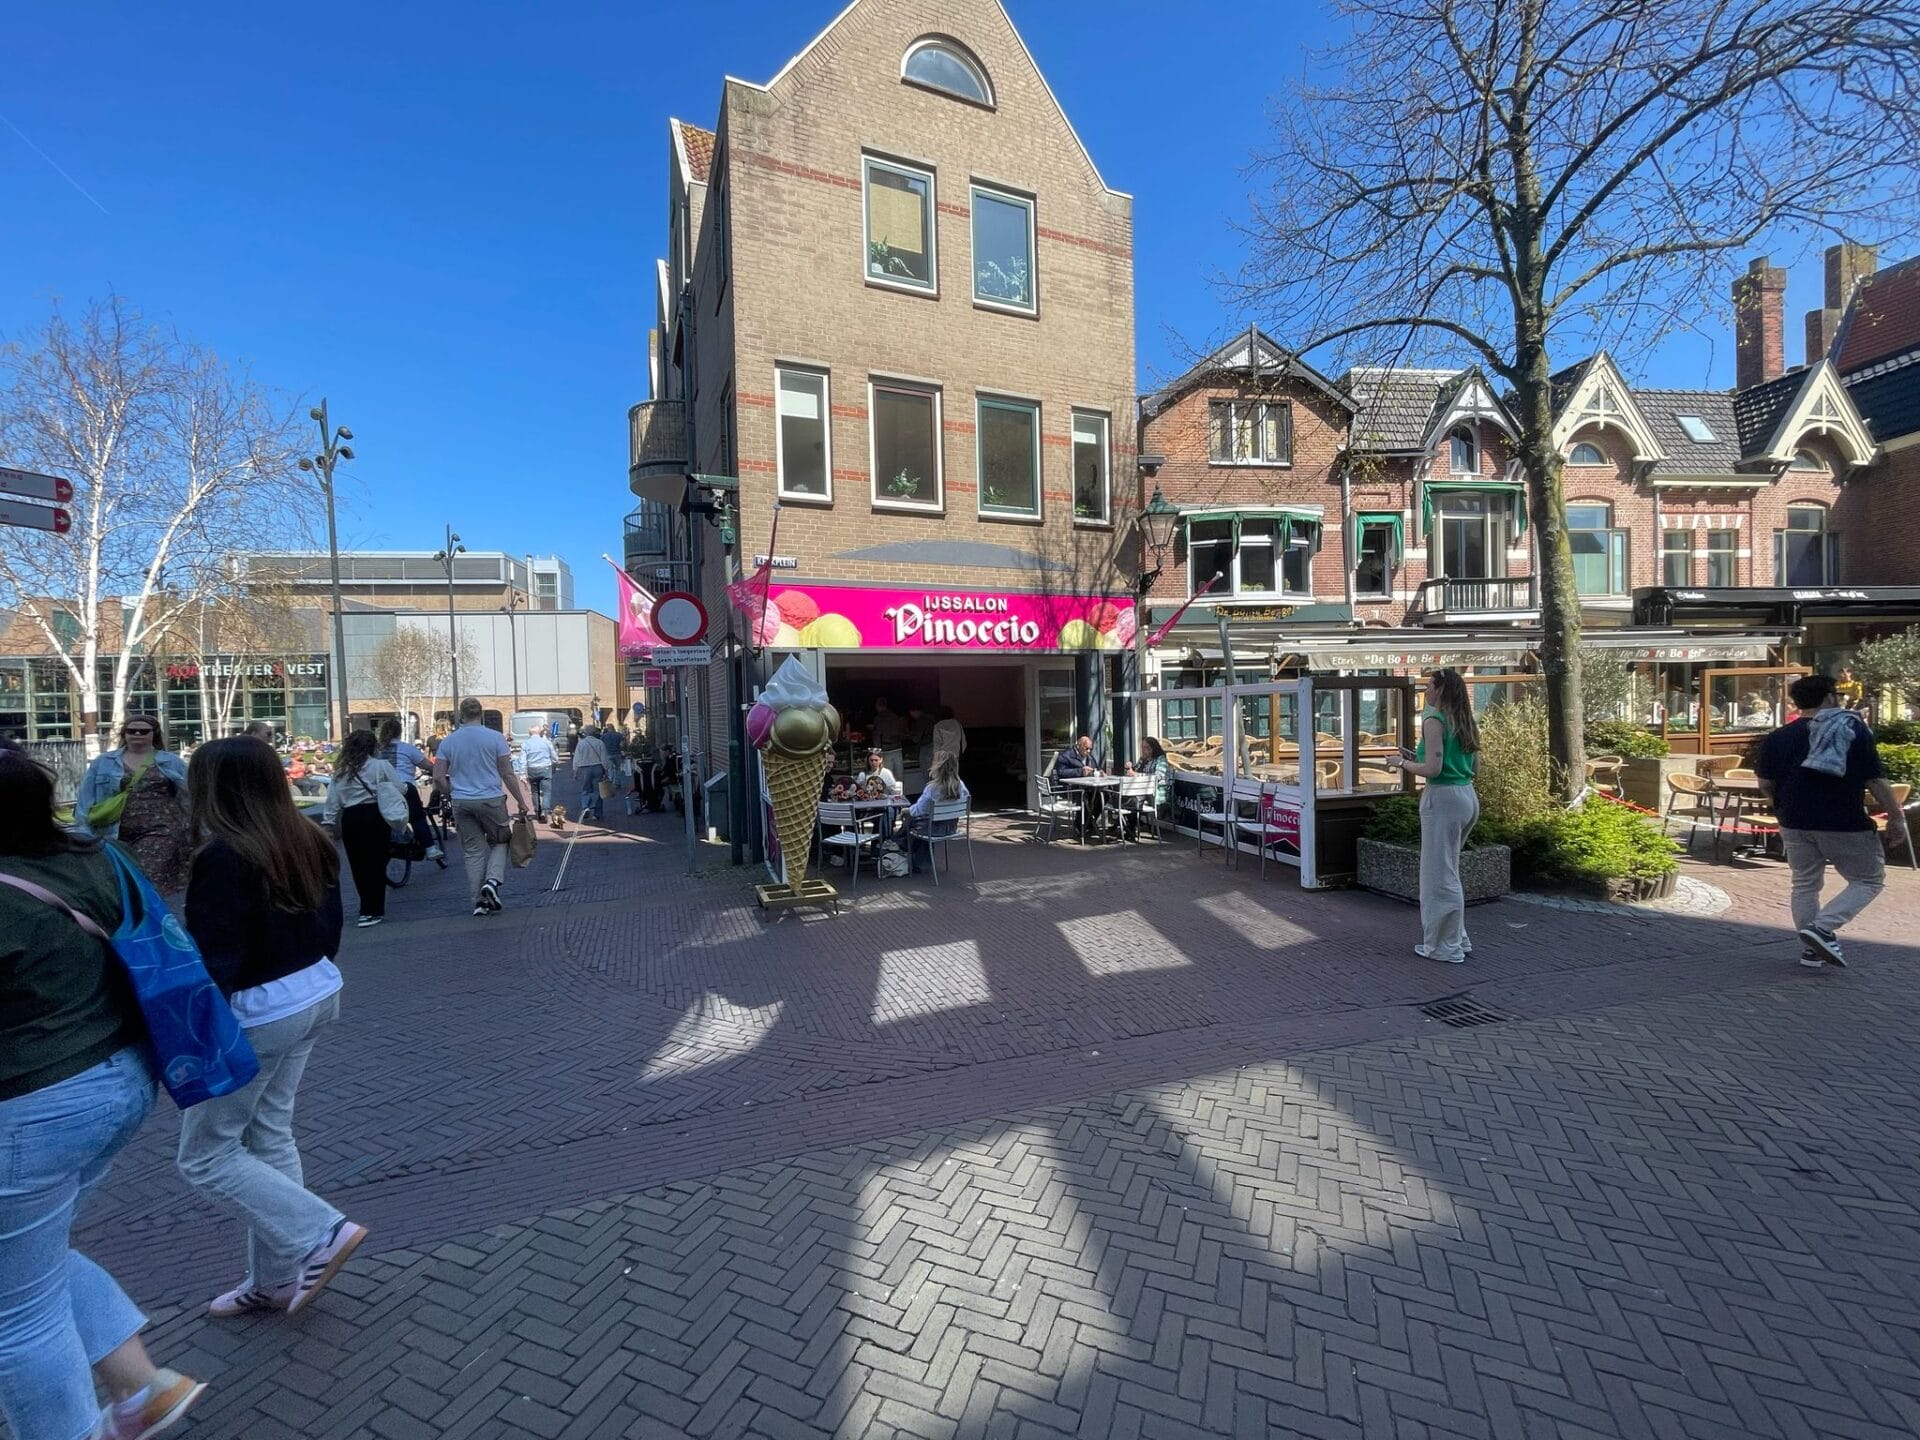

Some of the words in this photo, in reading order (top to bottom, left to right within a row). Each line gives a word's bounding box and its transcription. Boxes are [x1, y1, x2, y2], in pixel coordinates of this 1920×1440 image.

[757, 557, 796, 567] KEKPLEIN
[925, 595, 1007, 612] IJSSALON
[884, 603, 1040, 644] Pinoccio
[166, 664, 199, 677] AQA
[287, 663, 324, 676] VEST
